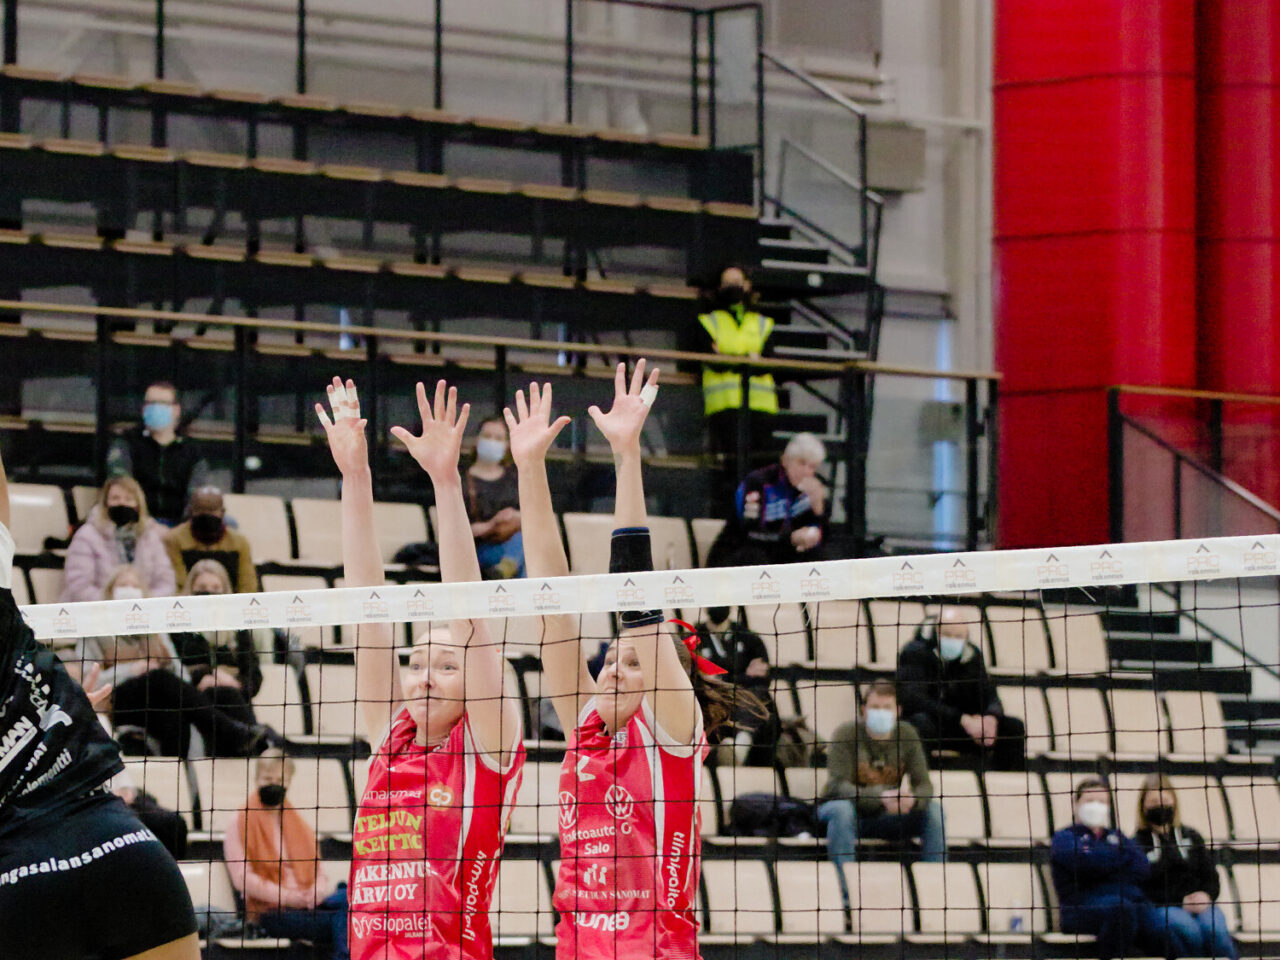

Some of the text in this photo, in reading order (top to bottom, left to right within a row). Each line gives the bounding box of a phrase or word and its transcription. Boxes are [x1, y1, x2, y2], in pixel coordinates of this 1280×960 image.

[584, 842, 611, 856] Salo
[352, 884, 419, 905] ÄRVI OY
